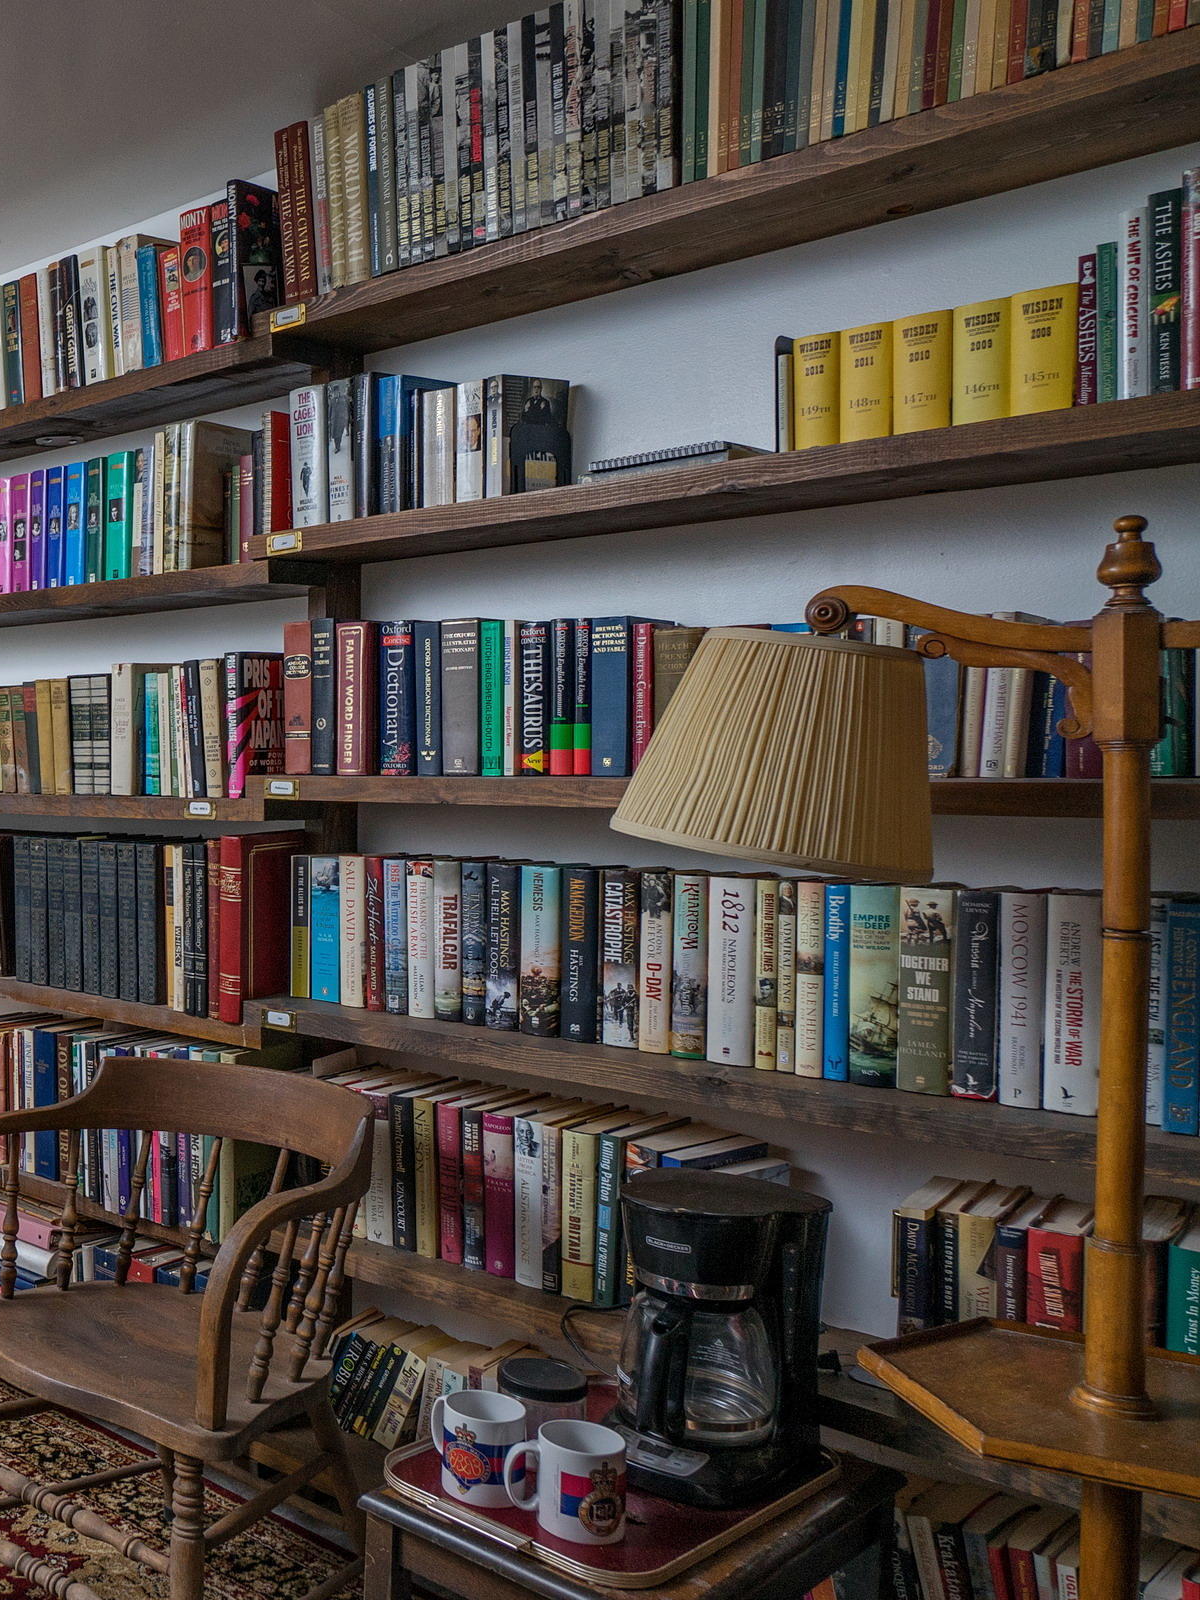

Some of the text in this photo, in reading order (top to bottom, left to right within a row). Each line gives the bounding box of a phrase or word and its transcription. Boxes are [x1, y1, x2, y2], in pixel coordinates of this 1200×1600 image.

[367, 88, 376, 126] SOLDIERS
[369, 140, 377, 171] FORTUNE
[228, 185, 236, 220] MONTY
[328, 136, 344, 248] WORLD WAR
[344, 132, 363, 244] WORLD WAR
[181, 209, 207, 230] MONTY
[300, 251, 310, 281] WAR
[1155, 202, 1172, 291] THE ASHES
[286, 254, 296, 285] WAR
[1127, 217, 1140, 338] THE WIT OF CRICKET
[1022, 298, 1064, 316] WISDEN
[1081, 290, 1093, 305] The
[849, 330, 882, 344] WISDEN
[903, 323, 939, 339] WISDEN
[964, 312, 1000, 329] WISDEN
[1078, 307, 1097, 364] ASHES
[800, 339, 831, 354] WISDEN
[909, 350, 930, 363] 2010
[970, 339, 993, 351] 2009
[1159, 332, 1170, 350] KEN
[805, 365, 824, 377] 2012
[855, 356, 874, 368] 2011
[293, 407, 315, 421] CAGED
[298, 392, 311, 403] THE
[296, 423, 313, 435] LION
[382, 623, 412, 637] Oxford
[383, 636, 410, 645] Concise
[521, 628, 546, 636] Oxford
[345, 639, 354, 682] FAMILY
[344, 687, 353, 721] WORD
[383, 647, 405, 752] Dictionary
[523, 645, 543, 749] THESAURUS
[556, 684, 564, 717] Grammar
[228, 712, 238, 742] JAPANESE
[344, 724, 353, 764] FINDER
[391, 864, 400, 882] 1815
[532, 872, 544, 912] NEMESIS
[346, 861, 355, 942] SAUL DAVID
[569, 877, 585, 942] ARMAGEDDON
[680, 882, 699, 950] KHARTOUM
[722, 889, 745, 934] 1812
[808, 891, 820, 949] CHARLES
[826, 895, 846, 946] Boothby
[853, 914, 890, 922] EMPIRE
[442, 894, 458, 971] TRAFALGAR
[490, 876, 499, 979] ALL HELL LET LOOSE
[500, 890, 510, 968] MAX HASTINGS
[604, 882, 623, 964] CATASTROPHE
[624, 882, 634, 965] MAX HASTINGS
[647, 919, 655, 959] BEEVOR
[763, 893, 774, 972] BEHIND ENEMY LINES
[864, 922, 891, 930] DEEP
[783, 920, 792, 1004] ADMIRAL BYNG
[901, 954, 949, 972] TOGETHER
[1060, 922, 1069, 966] ROBERTS
[1070, 922, 1081, 967] ANDREW
[569, 949, 579, 1002] HASTINGS
[645, 962, 662, 1001] D-DAY
[726, 939, 736, 1004] NAPOLEON'S
[915, 971, 931, 985] WE
[1011, 903, 1029, 1028] MOSCOW 1941
[907, 987, 940, 1003] STAND
[805, 981, 819, 1051] BLENHEIM
[1065, 971, 1083, 1067] THE STORM OF WAR
[1169, 979, 1196, 1089] ENGLAND
[59, 1042, 67, 1072] JOY
[414, 1107, 425, 1172] NELSON
[600, 1140, 614, 1202] Killing Patton
[394, 1179, 406, 1231] AZINCOURT
[568, 1215, 581, 1260] BRITAIN
[599, 1232, 608, 1244] BILL
[906, 1222, 920, 1250] DAVID
[1005, 1254, 1016, 1288] Investing
[1184, 1267, 1200, 1343] Trust In Money
